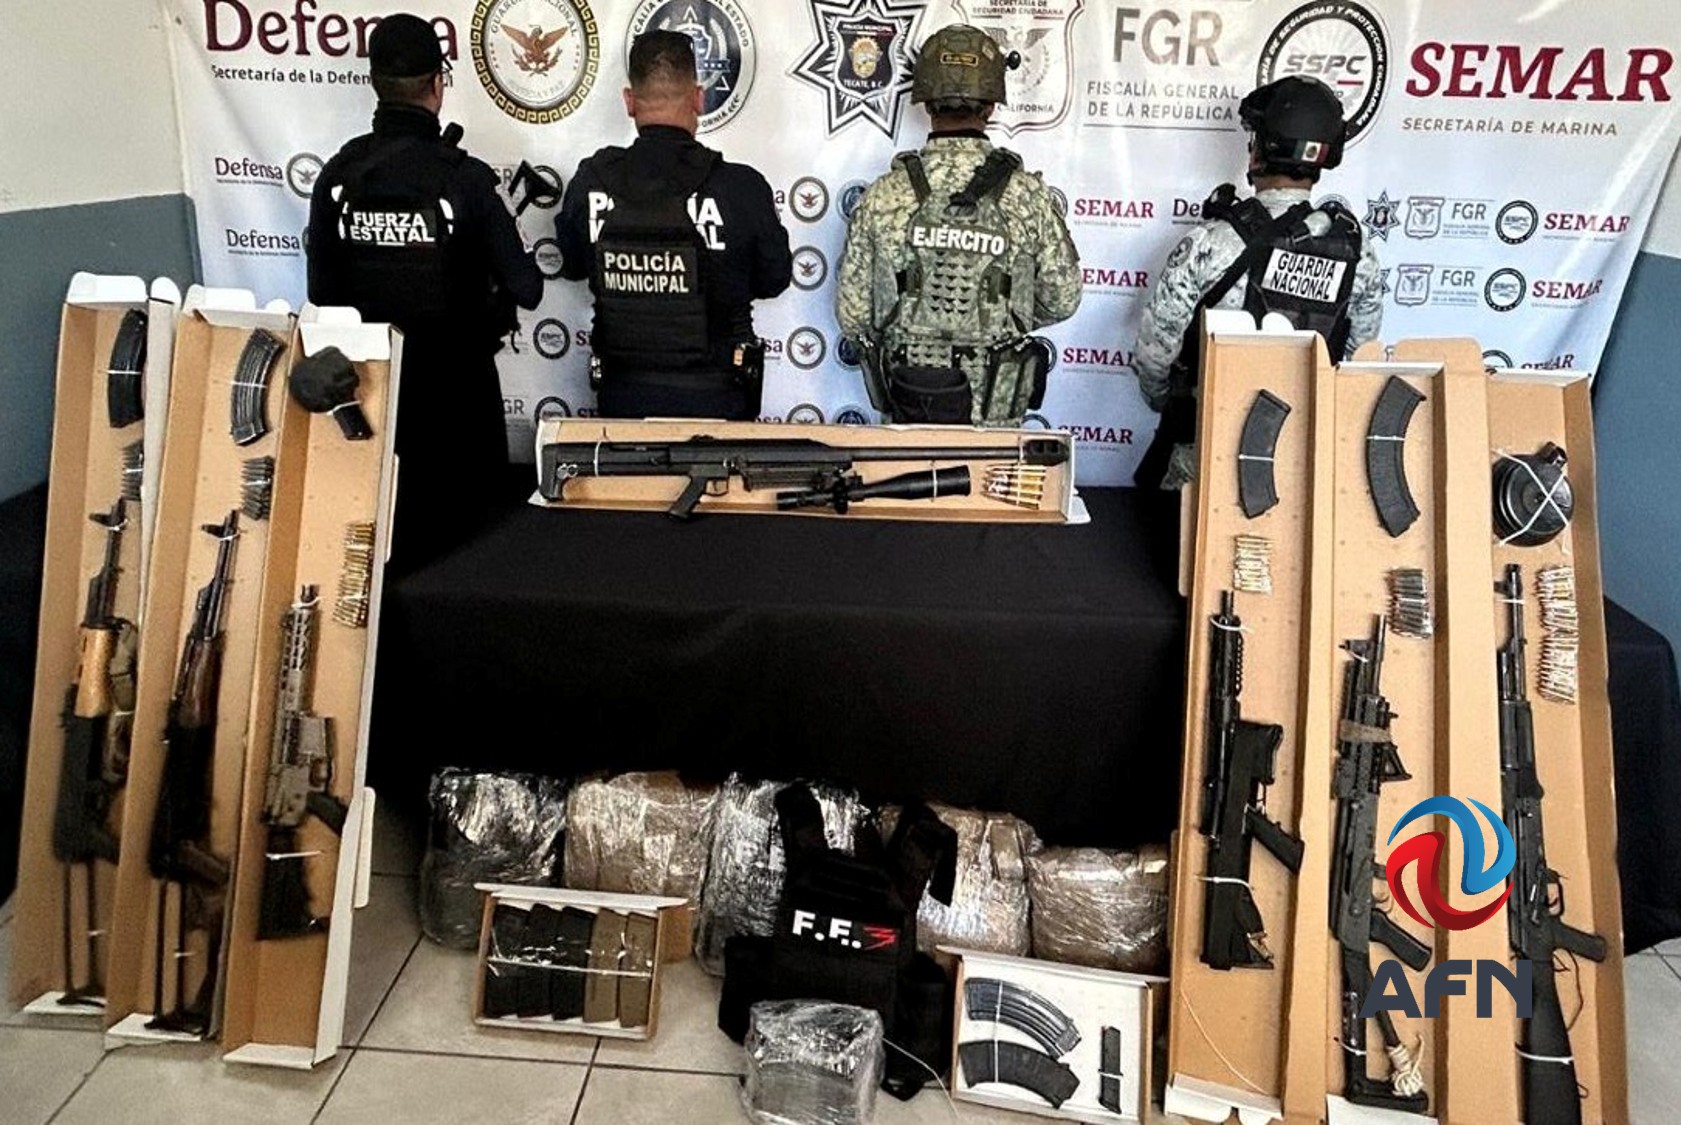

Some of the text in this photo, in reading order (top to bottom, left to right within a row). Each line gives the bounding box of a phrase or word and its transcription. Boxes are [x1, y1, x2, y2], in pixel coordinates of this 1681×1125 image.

[204, 0, 458, 61] Defea
[1113, 5, 1222, 66] FGR
[211, 64, 371, 85] Secretaría de la Defen
[1282, 54, 1367, 75] SSPC
[1405, 42, 1674, 102] SEMAR
[1087, 79, 1240, 100] FISCALÍA GENERAL
[1088, 101, 1234, 121] DE LA REPÚBLICA
[1402, 116, 1618, 137] SECRETARÍA DE MARINA
[215, 157, 283, 180] Defensa
[353, 210, 426, 228] FUERZA
[1073, 198, 1154, 219] SEMAR
[1451, 203, 1487, 220] FGR
[349, 224, 435, 243] ESTATAL
[1544, 213, 1631, 233] SEMAR
[226, 229, 300, 250] Defensa
[912, 224, 1006, 256] EJÉRCITO
[604, 251, 687, 272] POLICÍA
[1276, 251, 1336, 279] GUARDIA
[604, 271, 690, 293] MUNICIPAL
[1082, 268, 1149, 288] EMAR
[1271, 273, 1331, 300] NACIONAL
[1440, 270, 1475, 287] FGR
[1532, 279, 1601, 300] SEMAR
[503, 399, 525, 415] GR
[1058, 425, 1133, 445] EMAR
